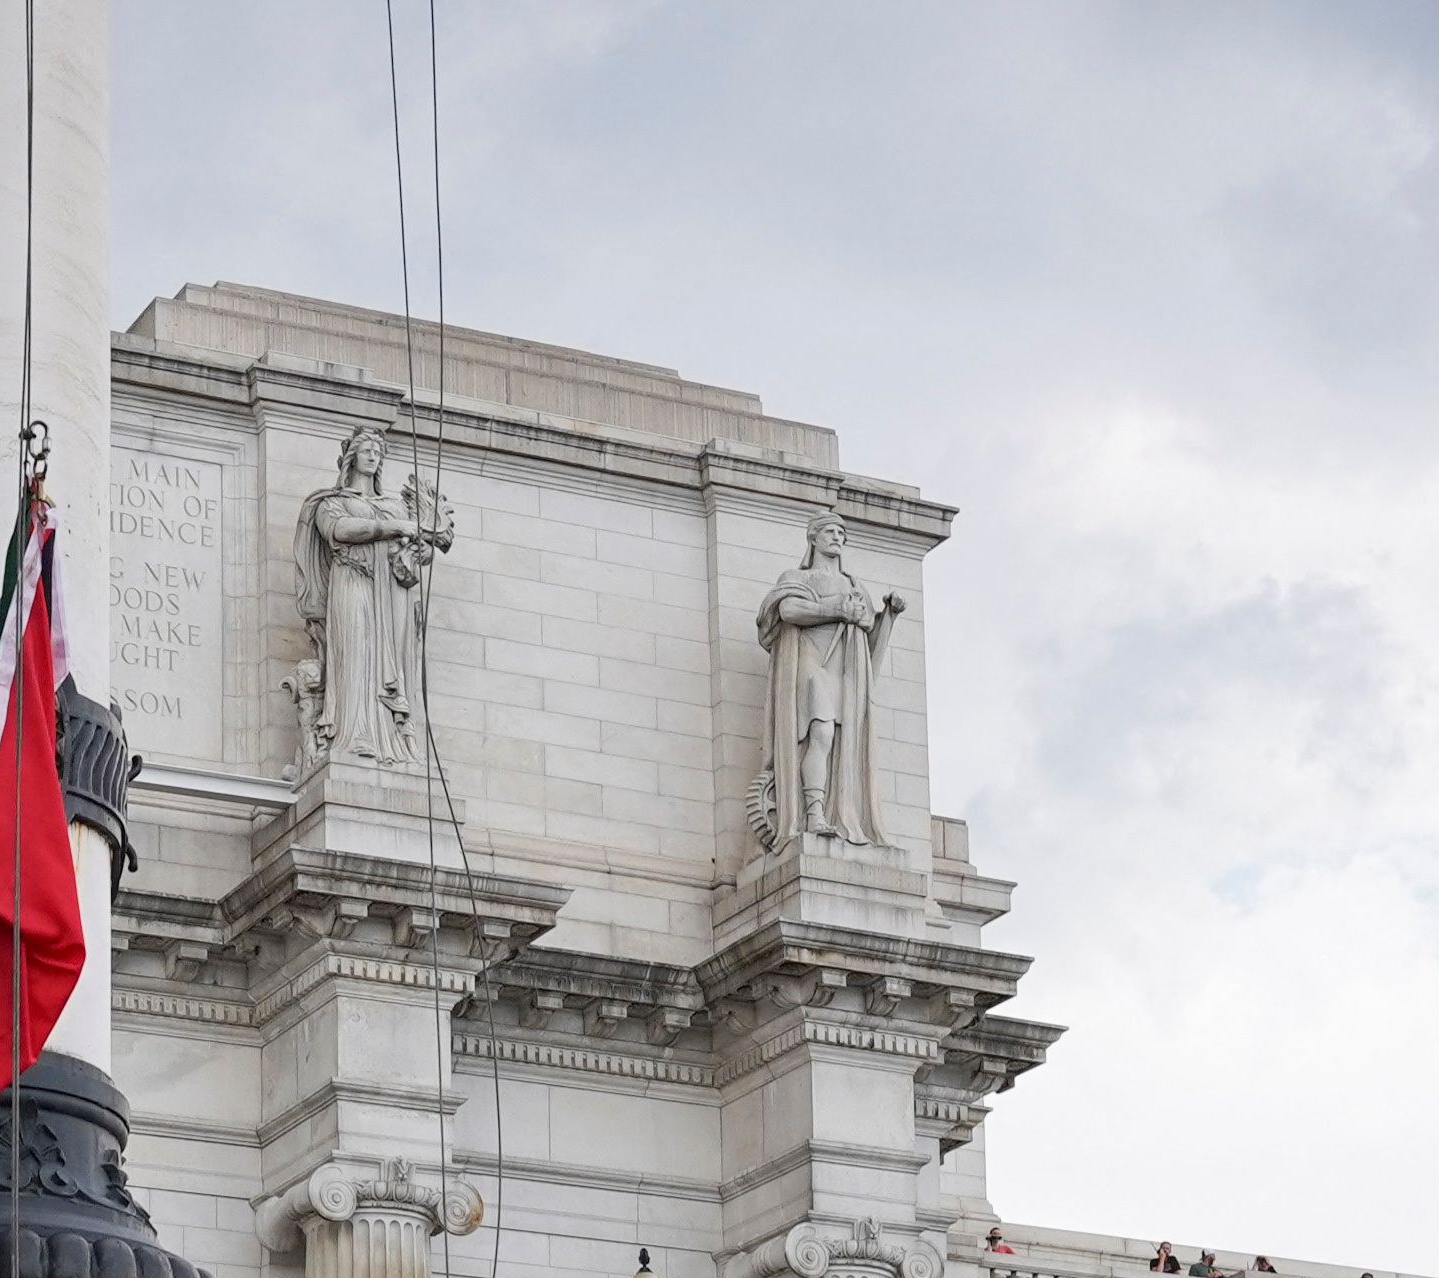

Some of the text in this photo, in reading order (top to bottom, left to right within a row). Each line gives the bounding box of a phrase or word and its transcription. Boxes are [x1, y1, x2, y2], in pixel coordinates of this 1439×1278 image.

[128, 459, 201, 490] MAIN
[183, 496, 217, 521] OF
[144, 562, 207, 592] NEW
[121, 614, 202, 647] MAKE
